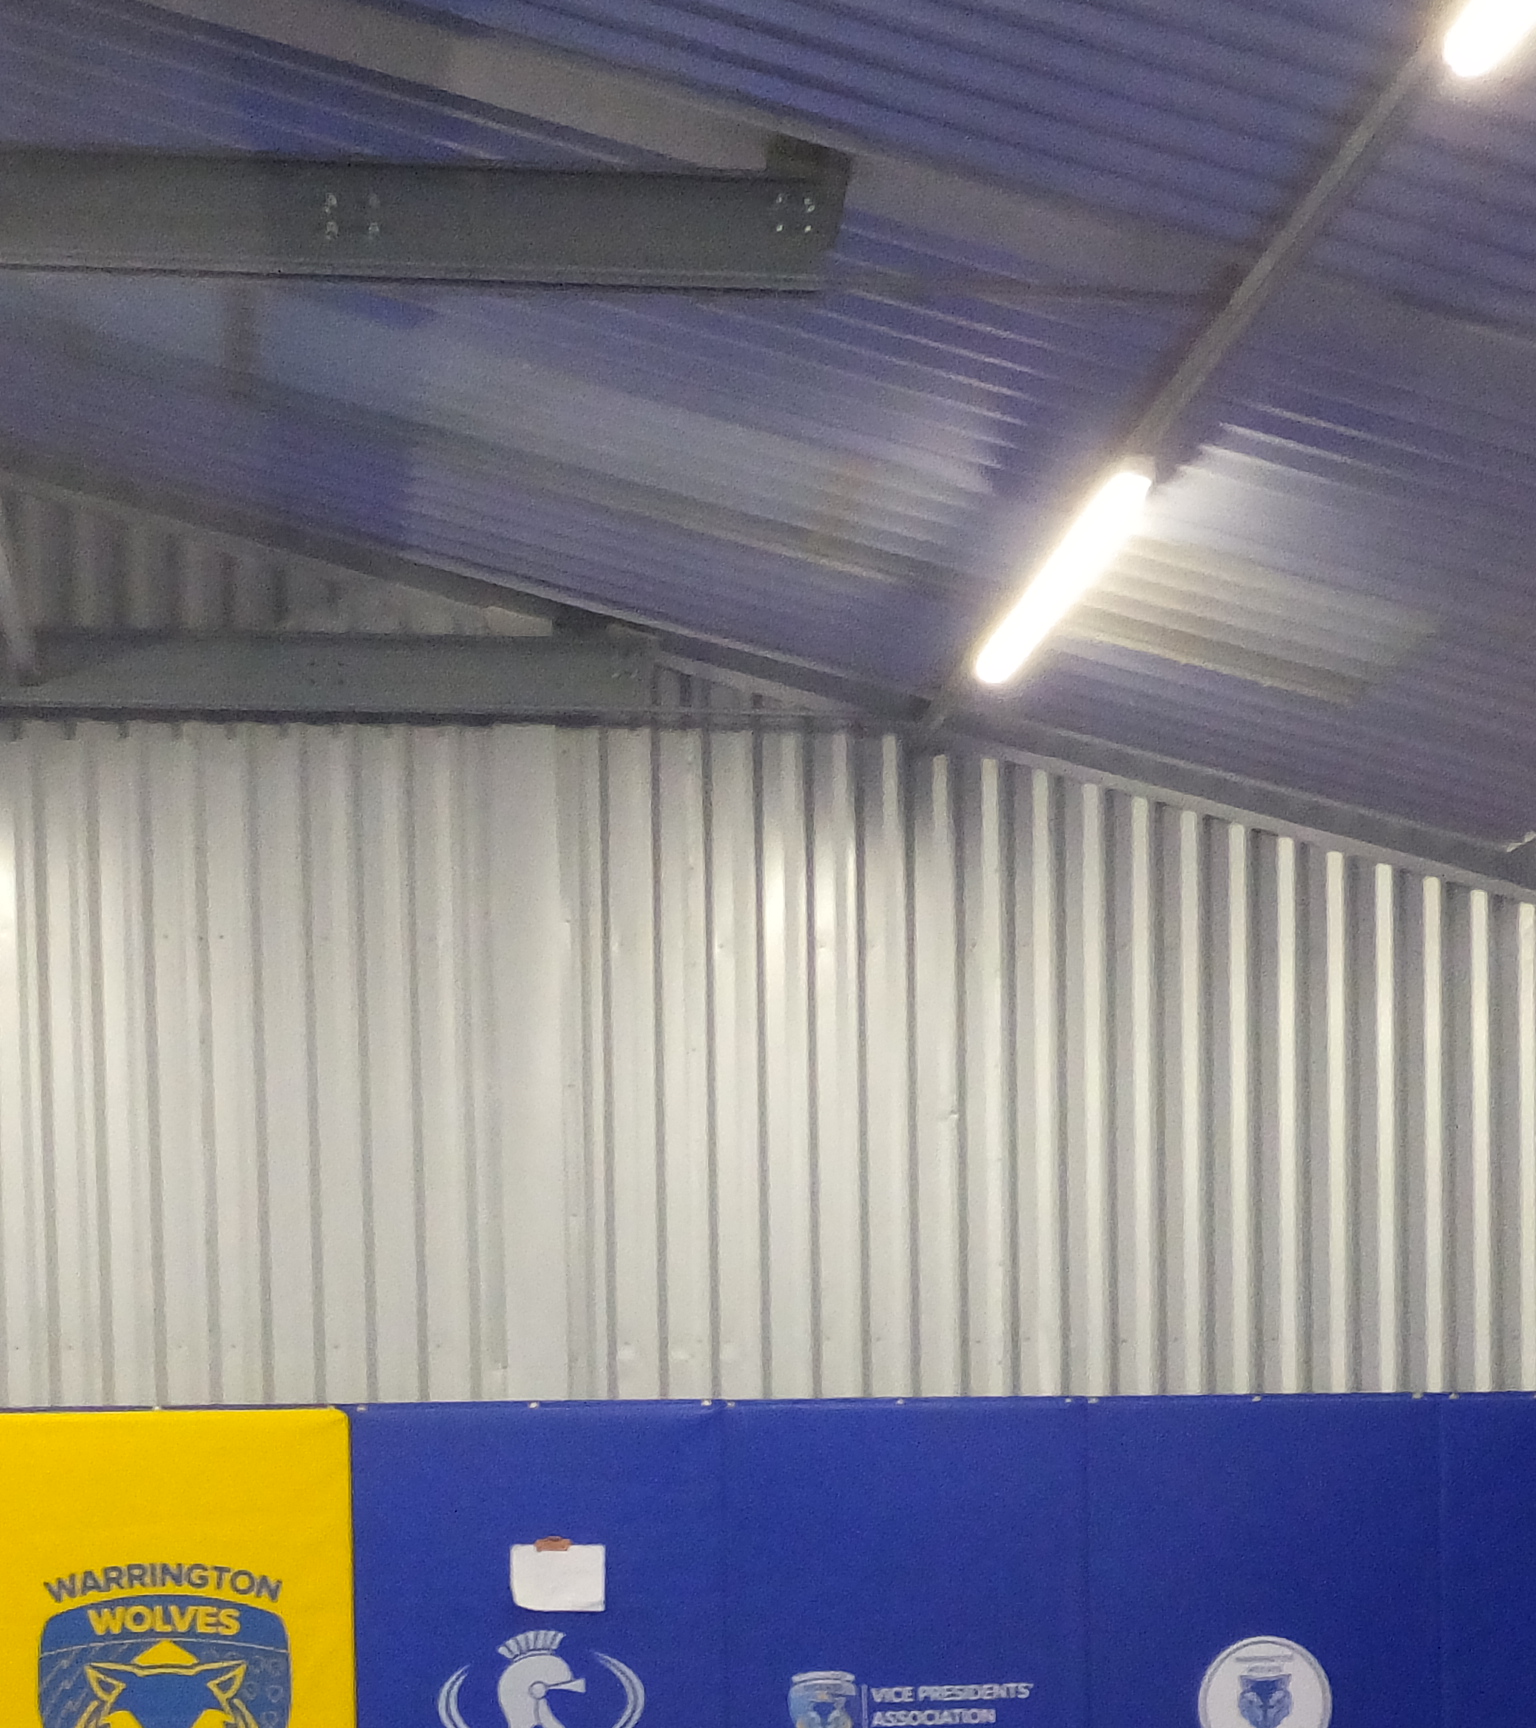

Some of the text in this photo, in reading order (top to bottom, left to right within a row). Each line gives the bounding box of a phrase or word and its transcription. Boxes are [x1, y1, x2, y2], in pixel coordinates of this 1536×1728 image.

[43, 1562, 283, 1603] WARRINGTON
[87, 1604, 241, 1636] WOLVES
[870, 1686, 914, 1703] VICE
[870, 1708, 997, 1728] ASSOCIATION
